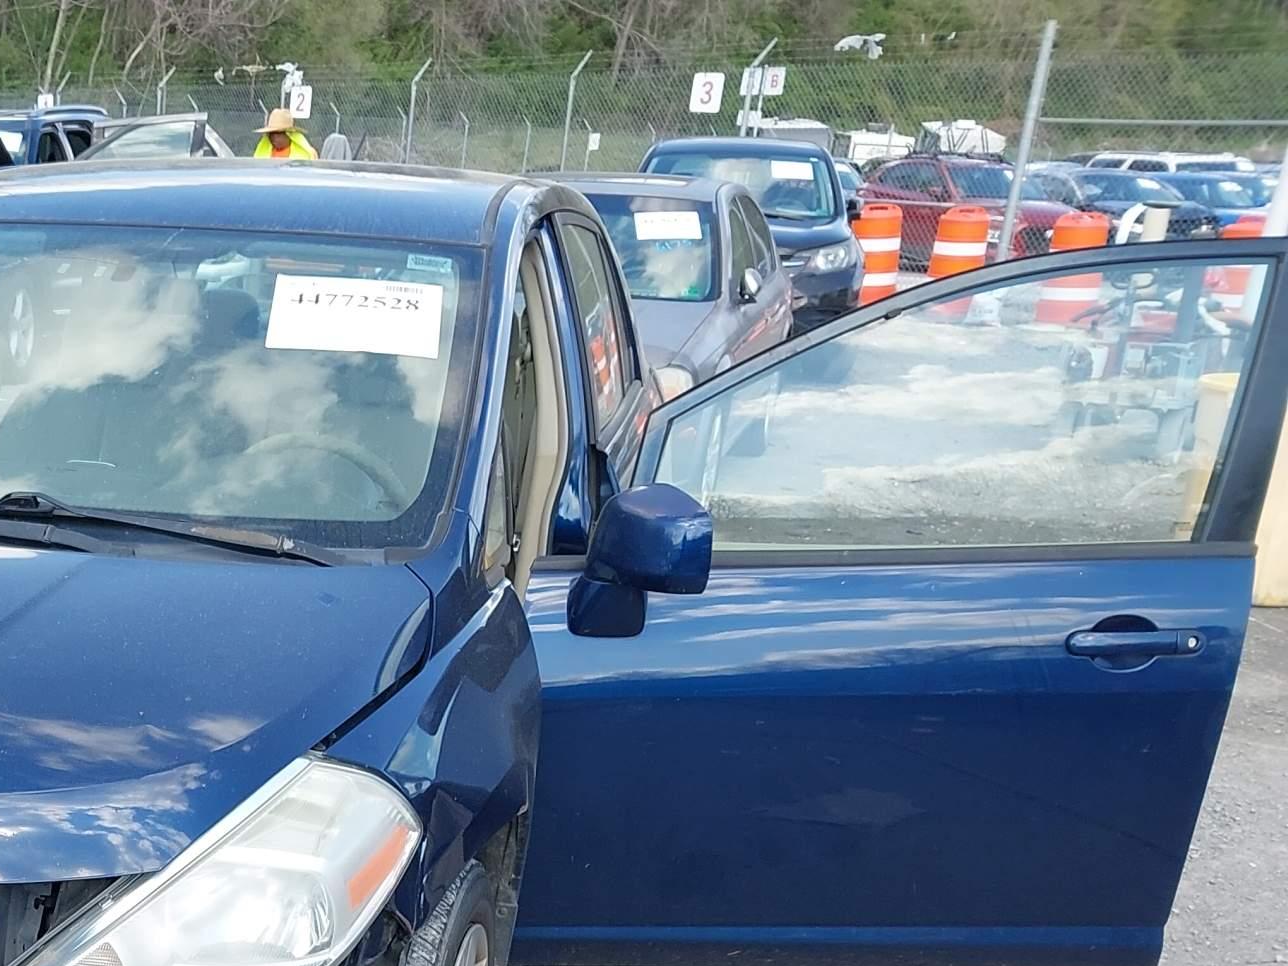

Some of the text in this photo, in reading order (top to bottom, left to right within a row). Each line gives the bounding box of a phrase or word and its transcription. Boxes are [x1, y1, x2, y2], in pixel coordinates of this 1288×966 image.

[295, 92, 305, 112] 2
[700, 81, 714, 104] 3
[290, 292, 420, 311] 44772528
